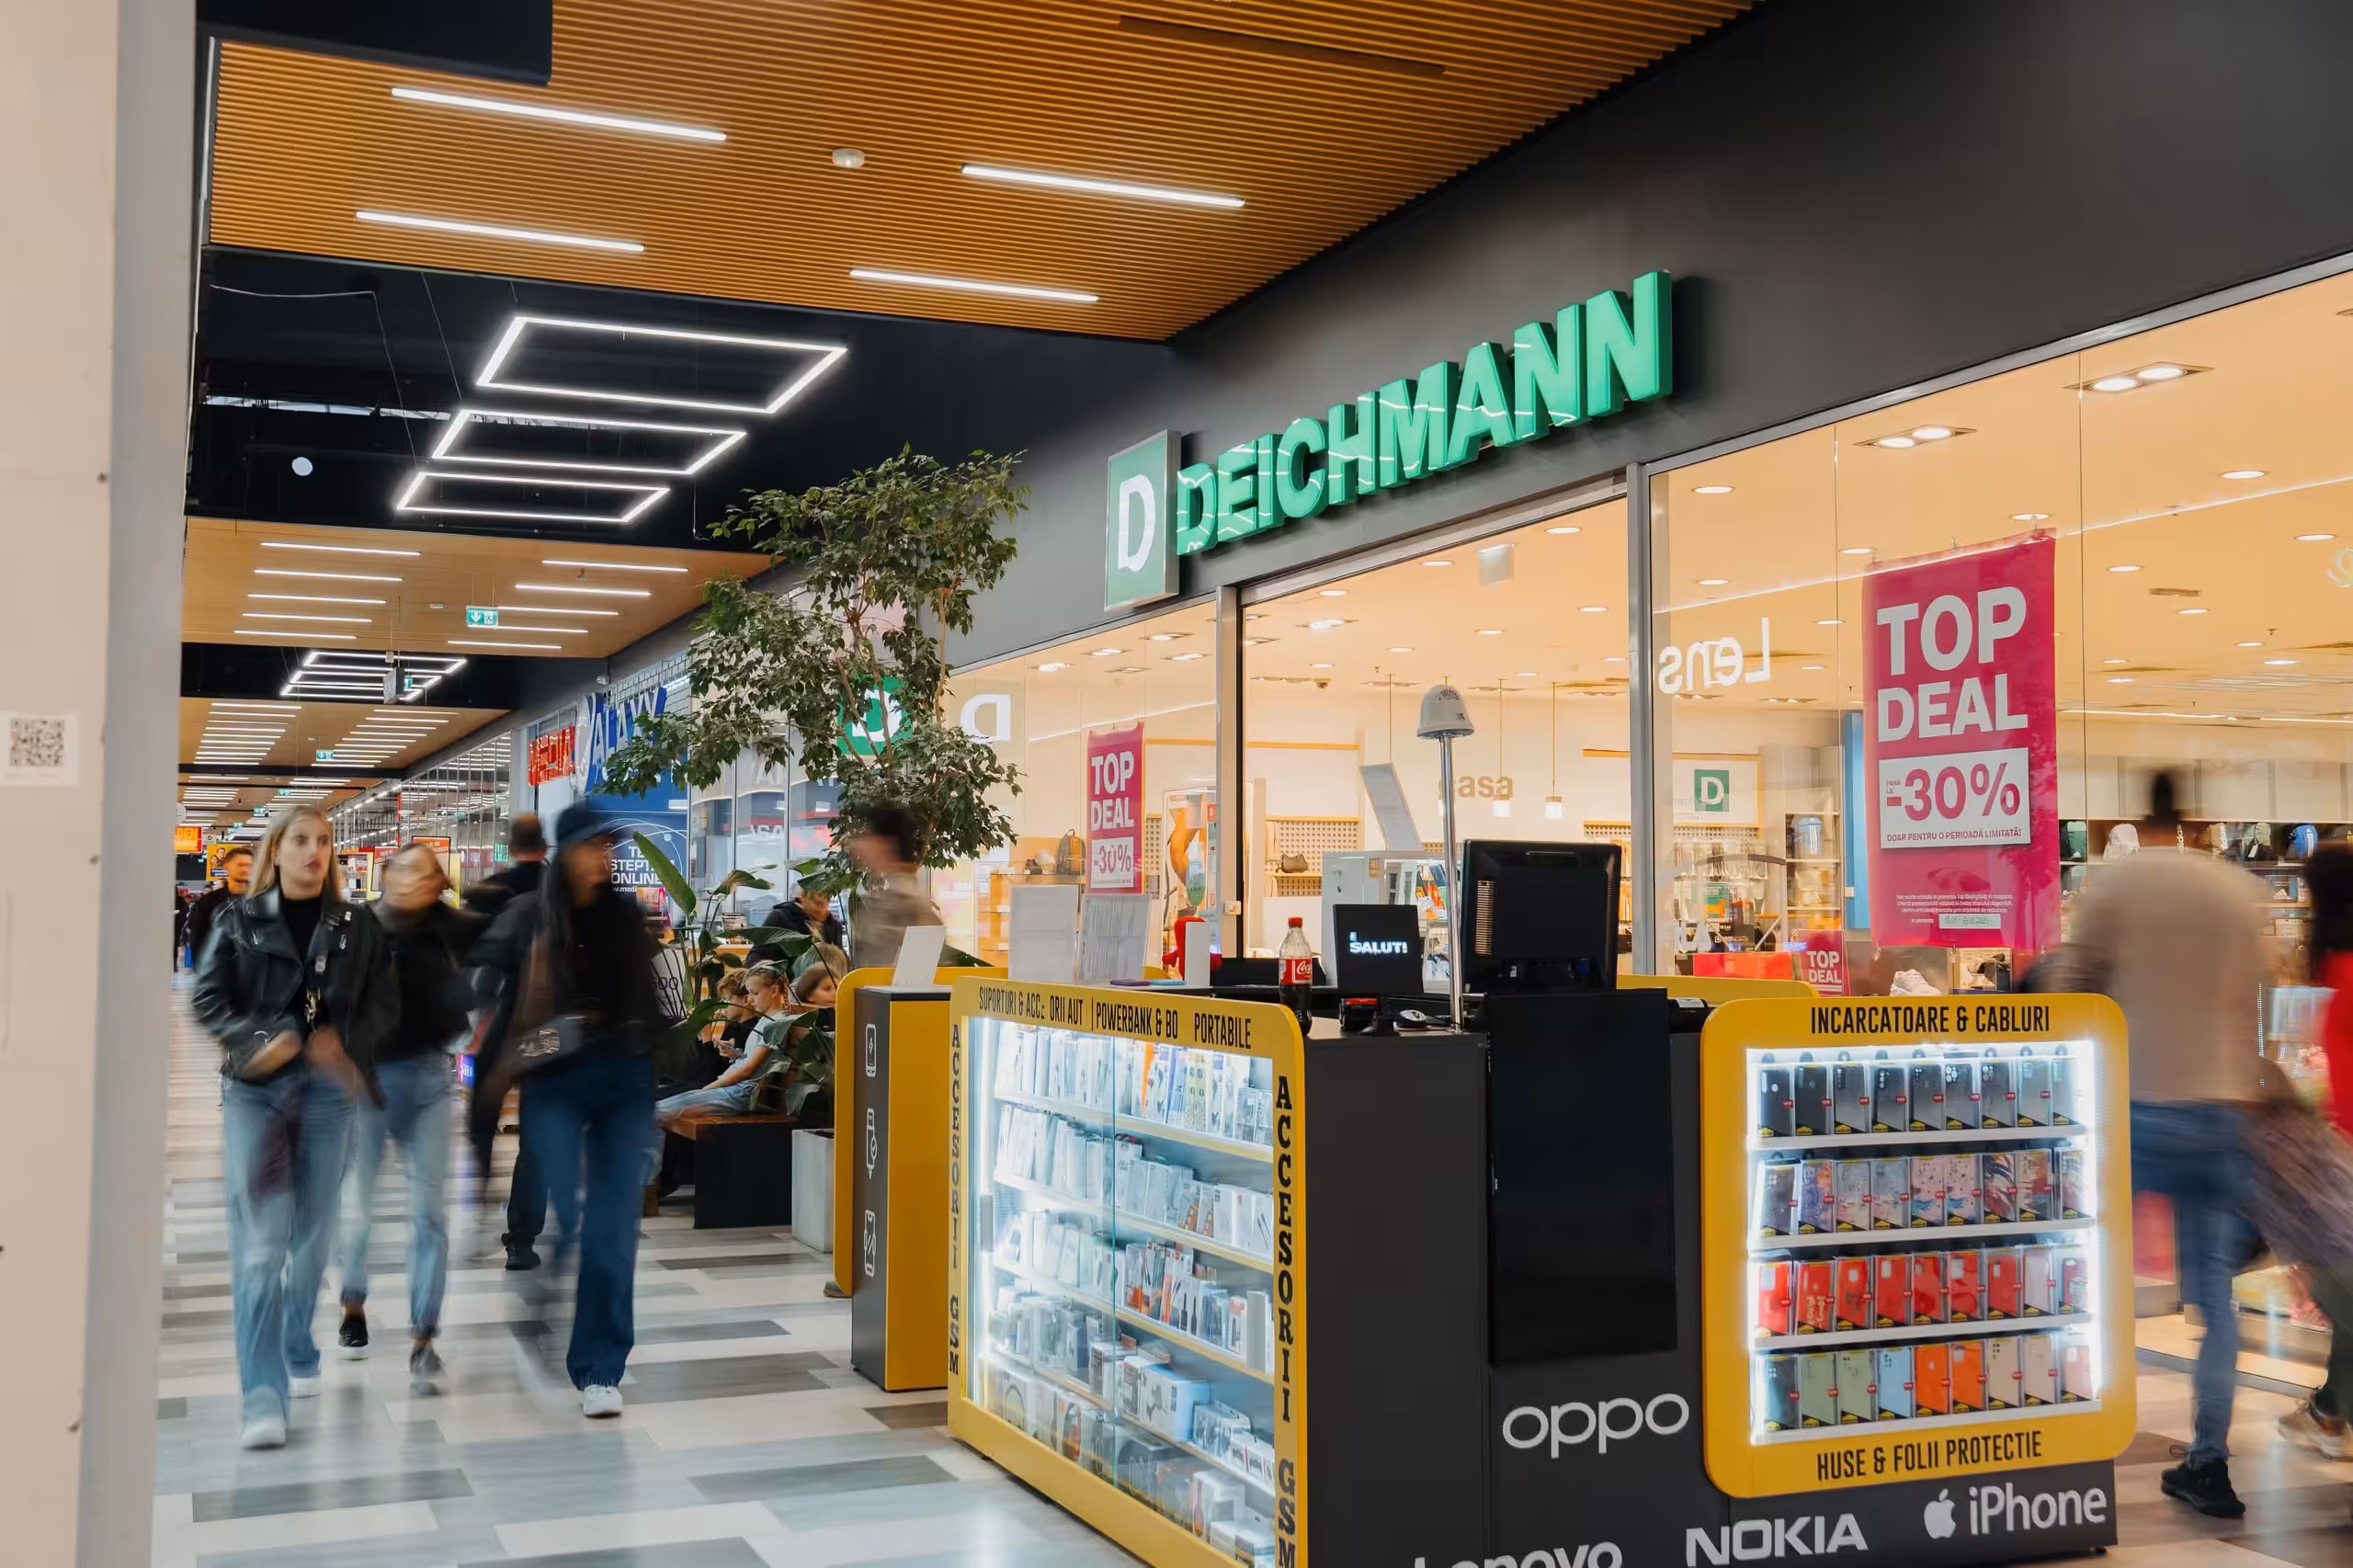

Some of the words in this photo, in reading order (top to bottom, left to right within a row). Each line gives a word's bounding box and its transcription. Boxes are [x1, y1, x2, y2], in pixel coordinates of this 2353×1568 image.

[1117, 472, 1154, 573] D
[1176, 270, 1673, 557] DEICHMANN
[1877, 585, 2028, 676] TOP
[1877, 673, 2029, 743] DEAL
[1091, 751, 1134, 795] TOP
[1438, 775, 1514, 798] asa
[1700, 777, 1725, 805] D
[1886, 762, 2020, 822] -30%
[1091, 797, 1134, 831] DEAL
[1887, 833, 1907, 842] DOAR
[1907, 830, 1938, 841] PENTRU
[1938, 831, 1945, 839] O
[1348, 940, 1408, 954] SALUT!
[1806, 949, 1840, 969] TOP
[1808, 969, 1842, 983] DEAL
[979, 986, 1017, 1017] SUPORTURI
[1096, 1002, 1153, 1036] POWERBANK
[1194, 1013, 1252, 1050] PORTABILE
[1811, 1006, 1949, 1034] INCARCATOARE
[1956, 1006, 1969, 1032] &
[1975, 1006, 2050, 1032] CABLURI
[950, 1023, 961, 1270] ACCESORII
[1275, 1074, 1294, 1424] ACCESORII
[949, 1293, 960, 1377] GSM
[1817, 1449, 1867, 1481] HUSE
[1873, 1447, 1886, 1474] &
[1893, 1440, 1939, 1473] FOLII
[1946, 1430, 2042, 1467] PROTECTIE
[1277, 1458, 1296, 1568] GSM
[1968, 1483, 2108, 1537] iPhone
[1685, 1512, 1869, 1568] NOKIA
